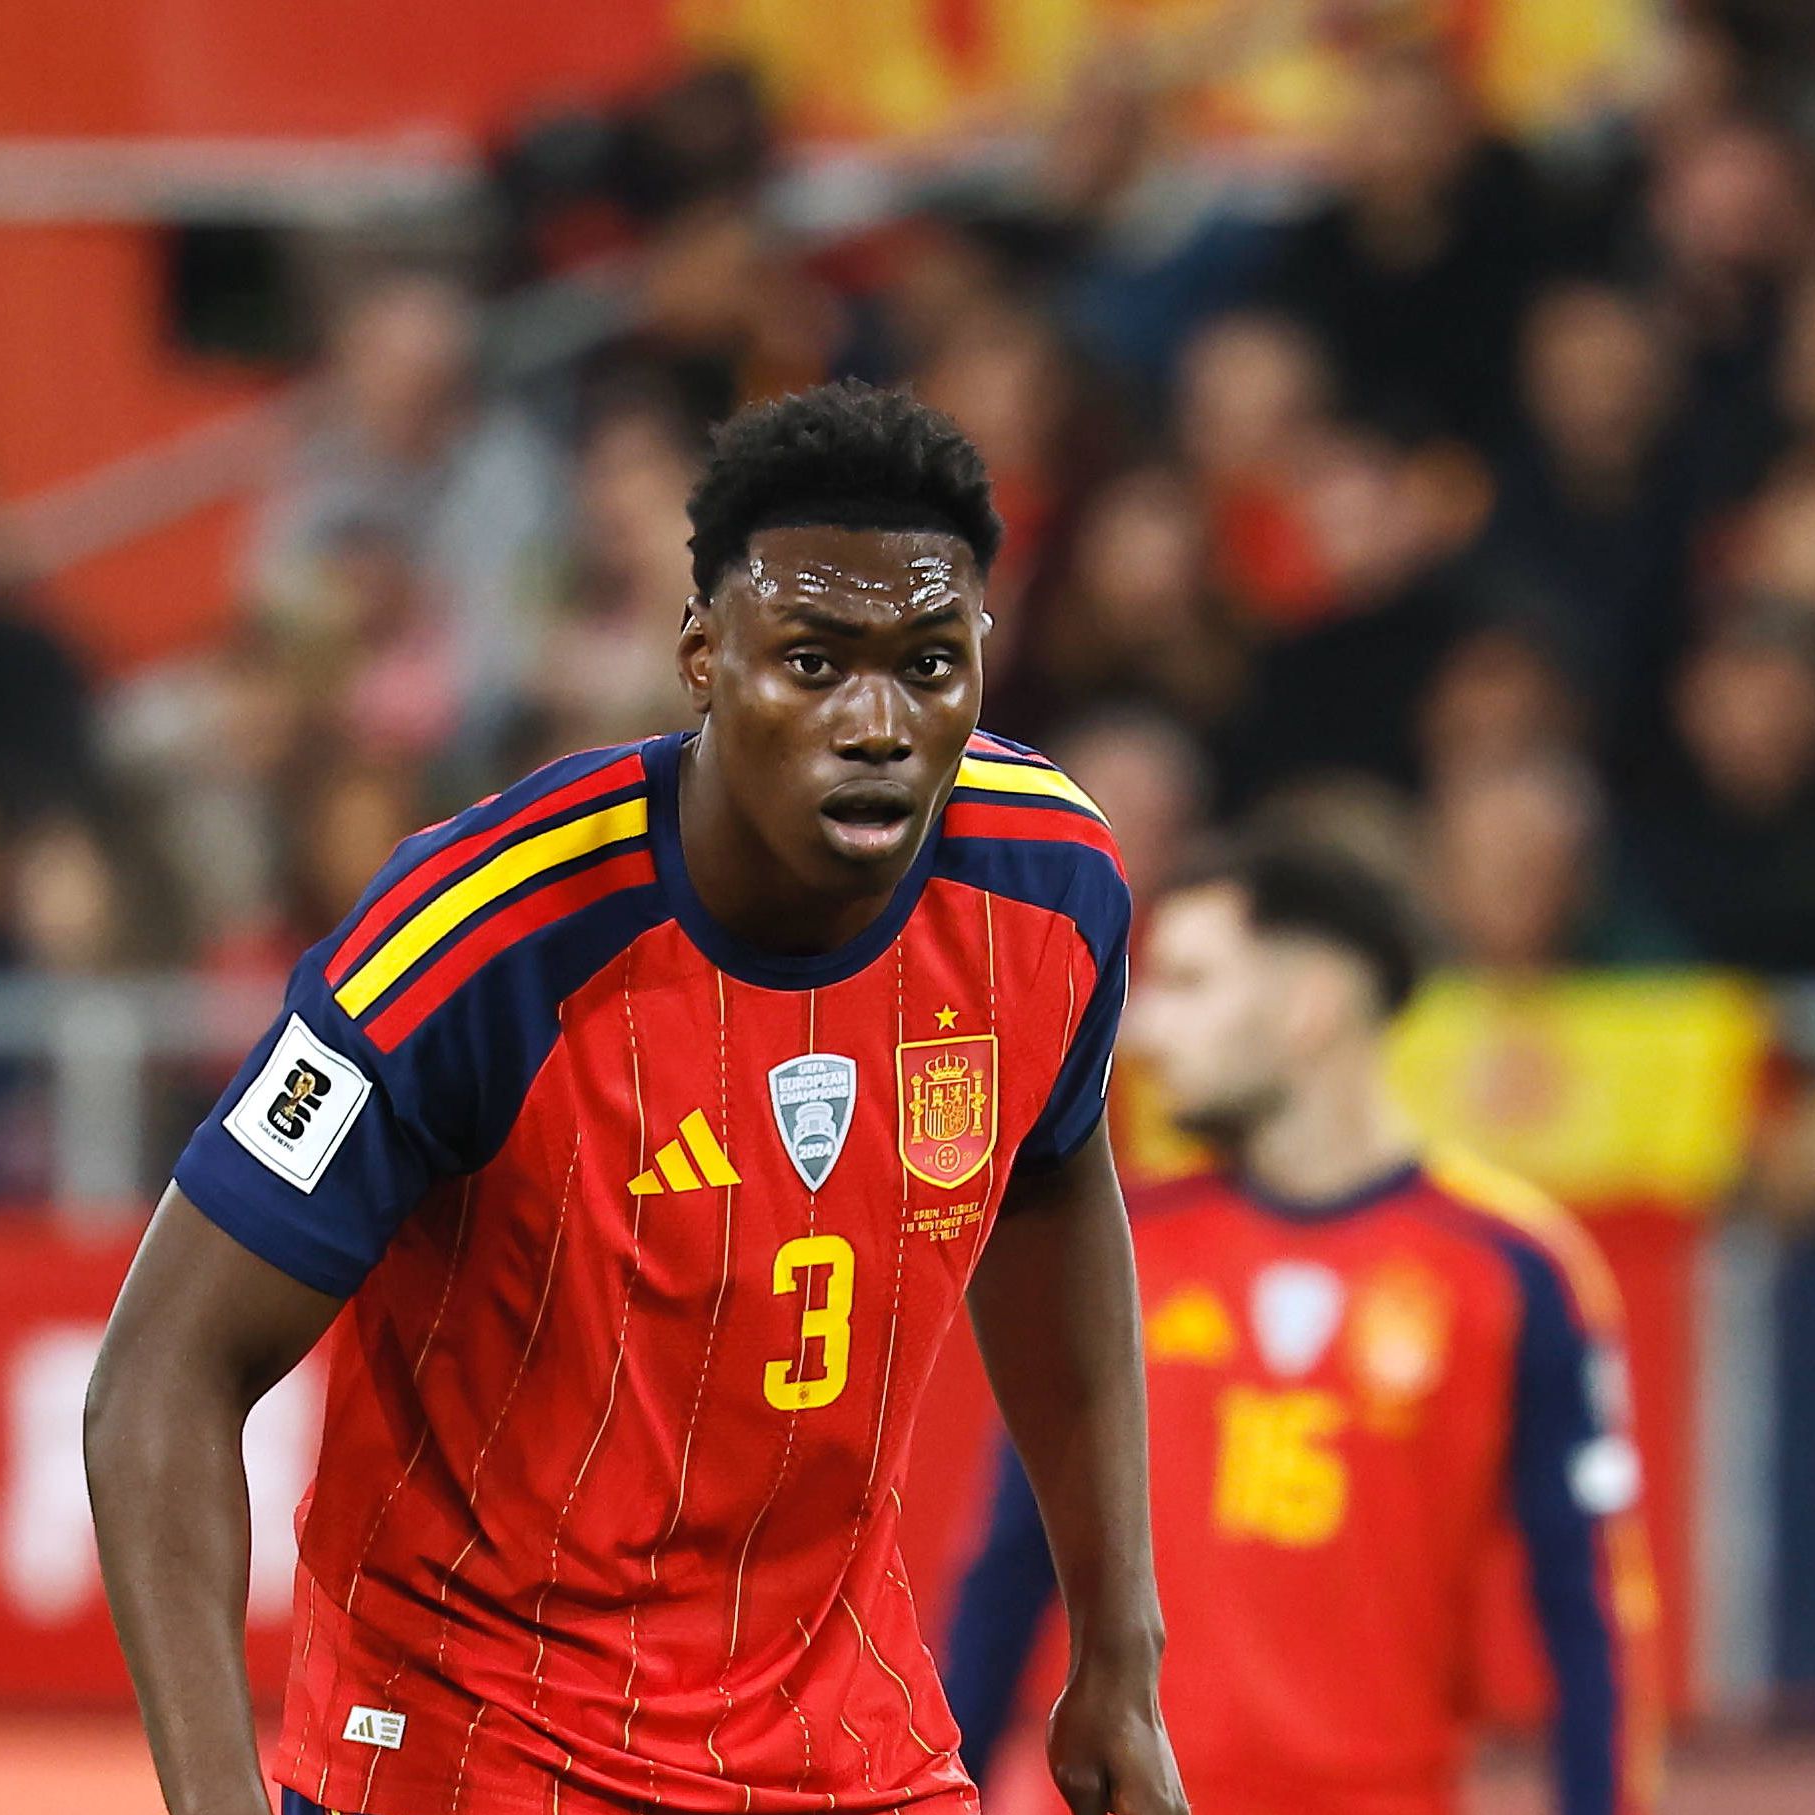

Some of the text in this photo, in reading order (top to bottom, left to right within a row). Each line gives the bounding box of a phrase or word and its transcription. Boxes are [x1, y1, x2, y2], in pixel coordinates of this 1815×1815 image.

[778, 1070, 848, 1092] EUROPEAN
[779, 1085, 849, 1105] CHAMPIONS
[273, 1111, 292, 1132] FIFA
[798, 1140, 833, 1160] 2024
[763, 1234, 855, 1411] 3
